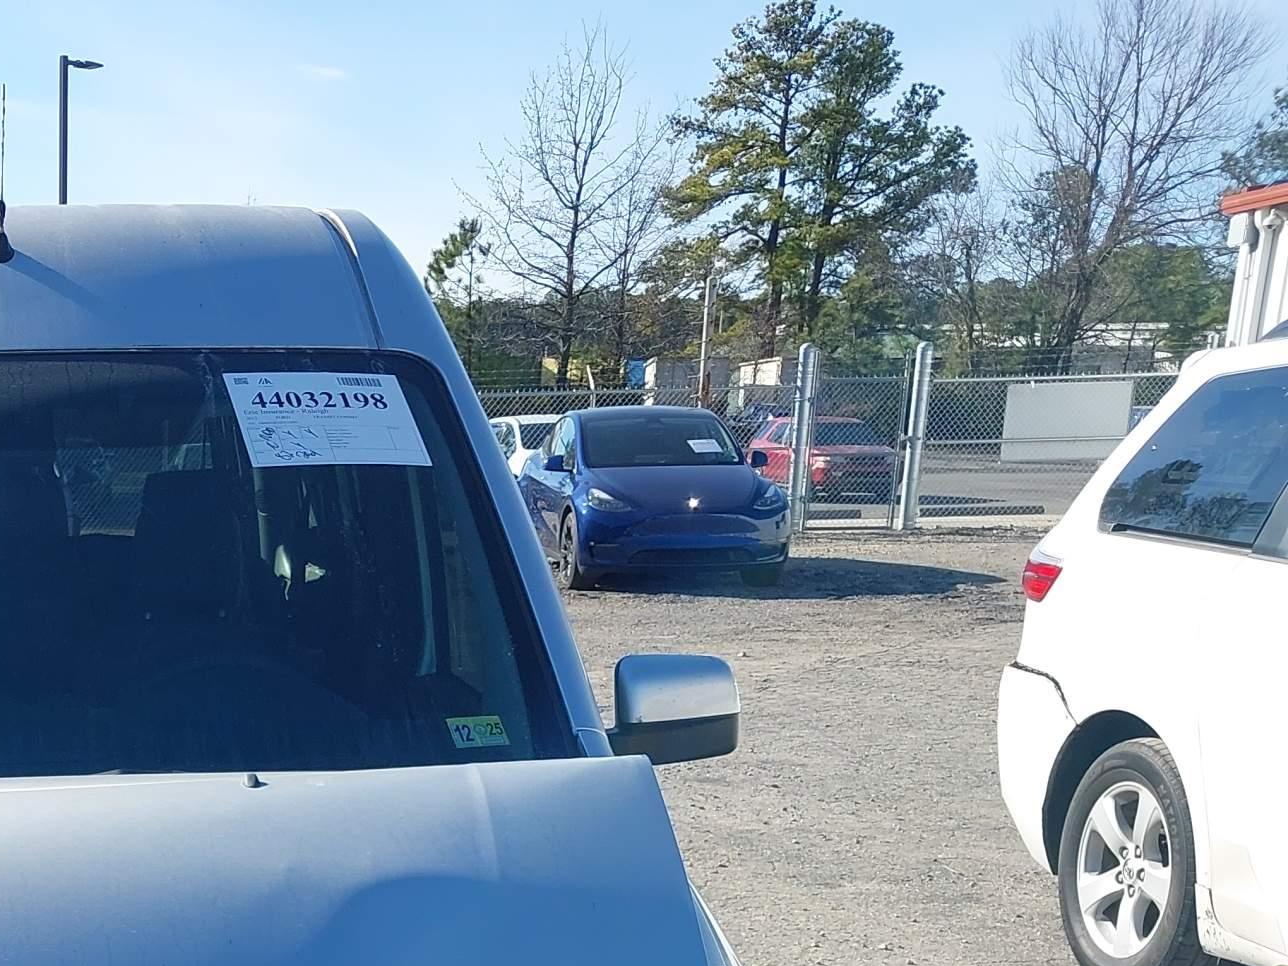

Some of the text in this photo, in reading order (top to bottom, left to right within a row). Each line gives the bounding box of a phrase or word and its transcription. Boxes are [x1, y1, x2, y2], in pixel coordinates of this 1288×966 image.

[251, 391, 389, 410] 44032198
[454, 723, 476, 743] 12
[486, 722, 504, 736] 25
